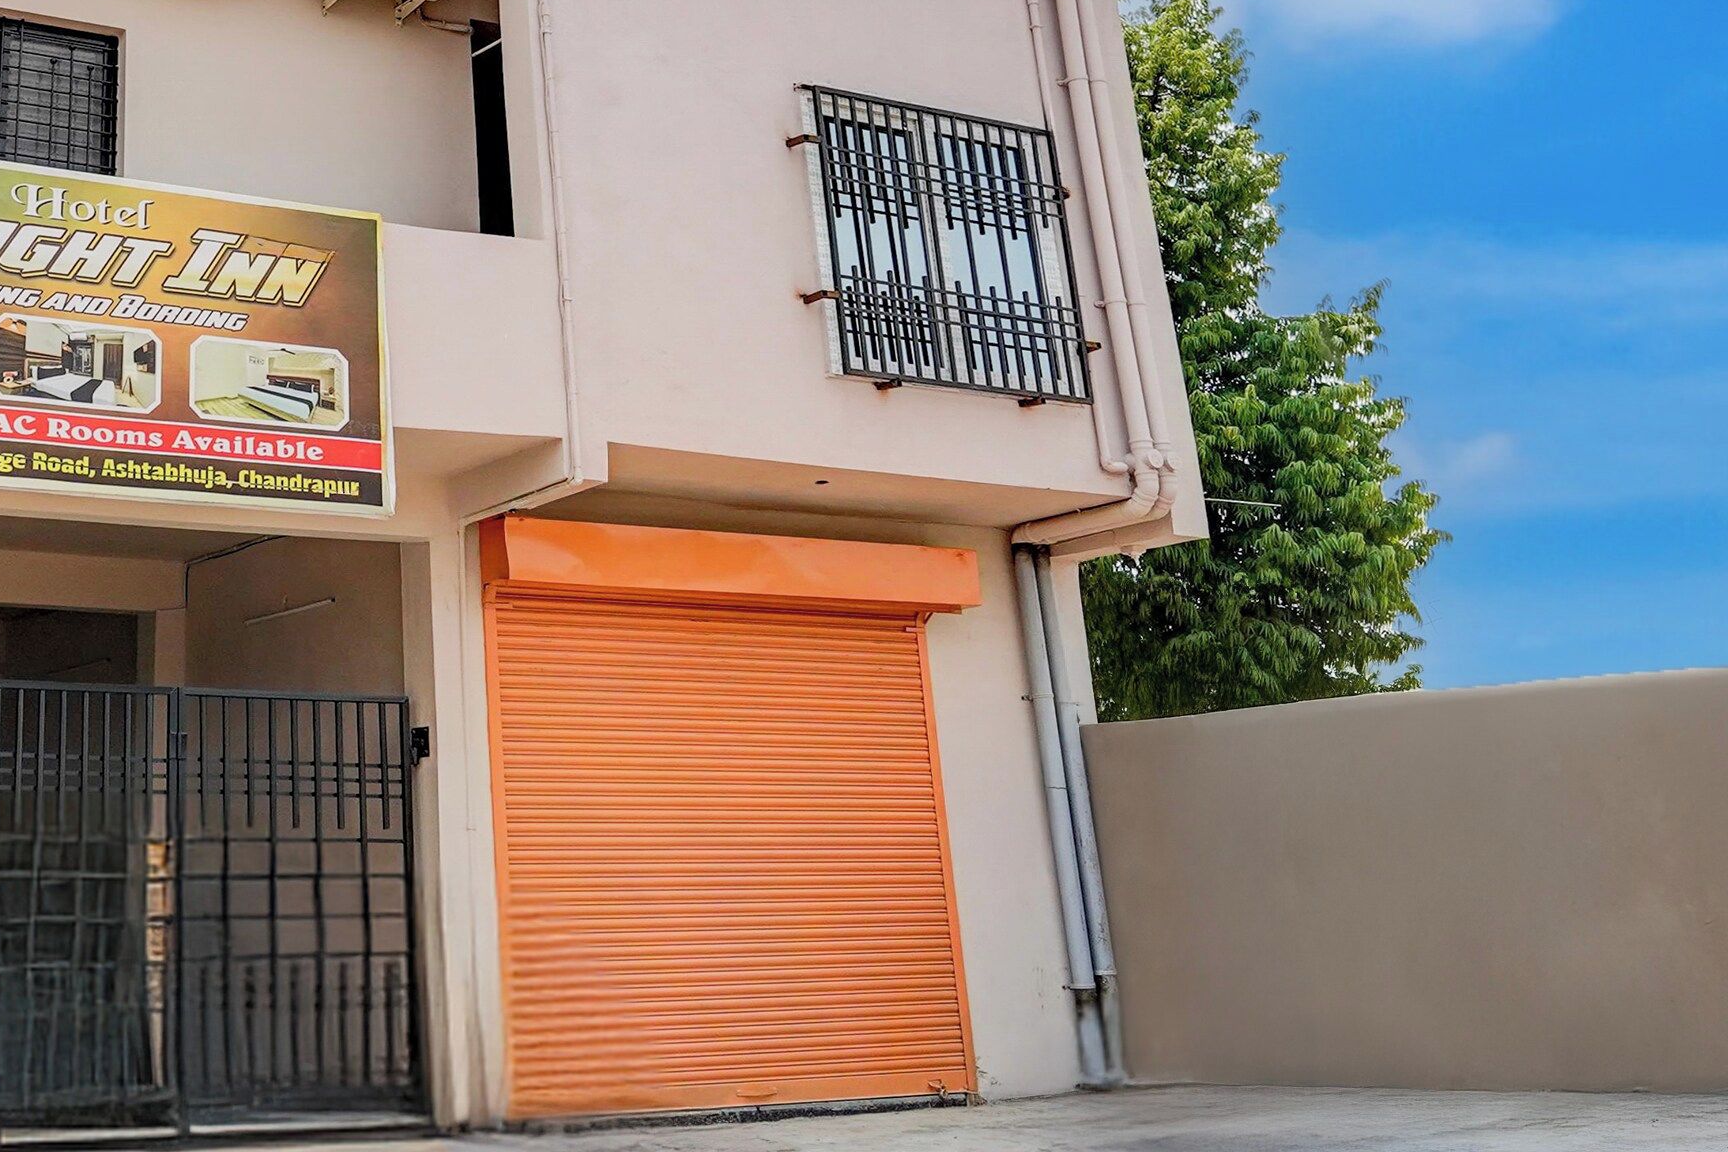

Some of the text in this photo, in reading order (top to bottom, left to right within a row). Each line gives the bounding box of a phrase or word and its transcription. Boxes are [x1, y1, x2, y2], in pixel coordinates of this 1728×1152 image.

[11, 183, 154, 229] Hotel
[161, 227, 335, 308] INN
[39, 291, 114, 316] AND
[47, 417, 164, 448] Rooms
[172, 429, 325, 461] Available
[32, 451, 96, 478] Road,
[238, 469, 360, 498] Chandrapur
